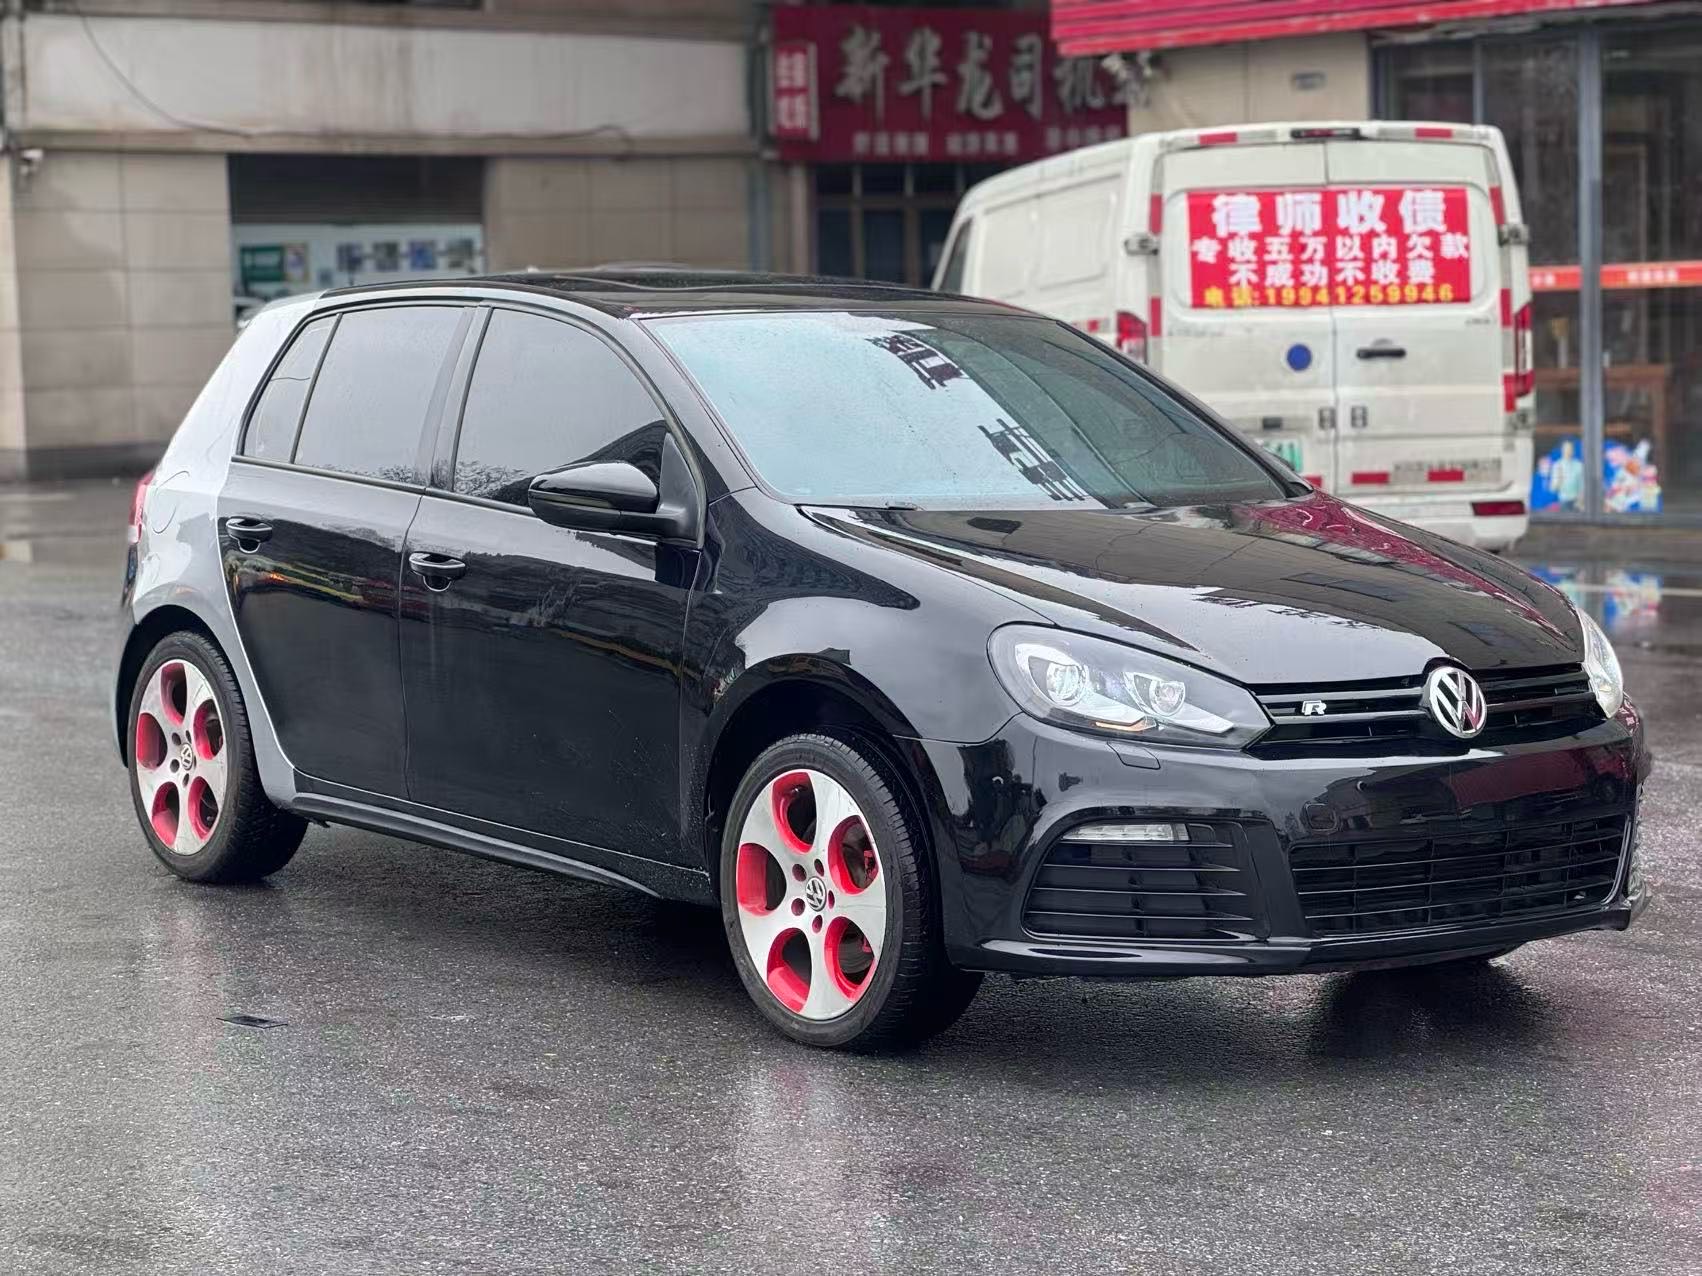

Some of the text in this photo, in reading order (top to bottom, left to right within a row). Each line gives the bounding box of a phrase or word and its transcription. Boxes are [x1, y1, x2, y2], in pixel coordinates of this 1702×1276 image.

[1211, 189, 1447, 237] 律师收债
[1190, 232, 1471, 263] 专收五万以内欠款
[1228, 257, 1436, 288] 不成功不收费
[1302, 700, 1327, 716] R
